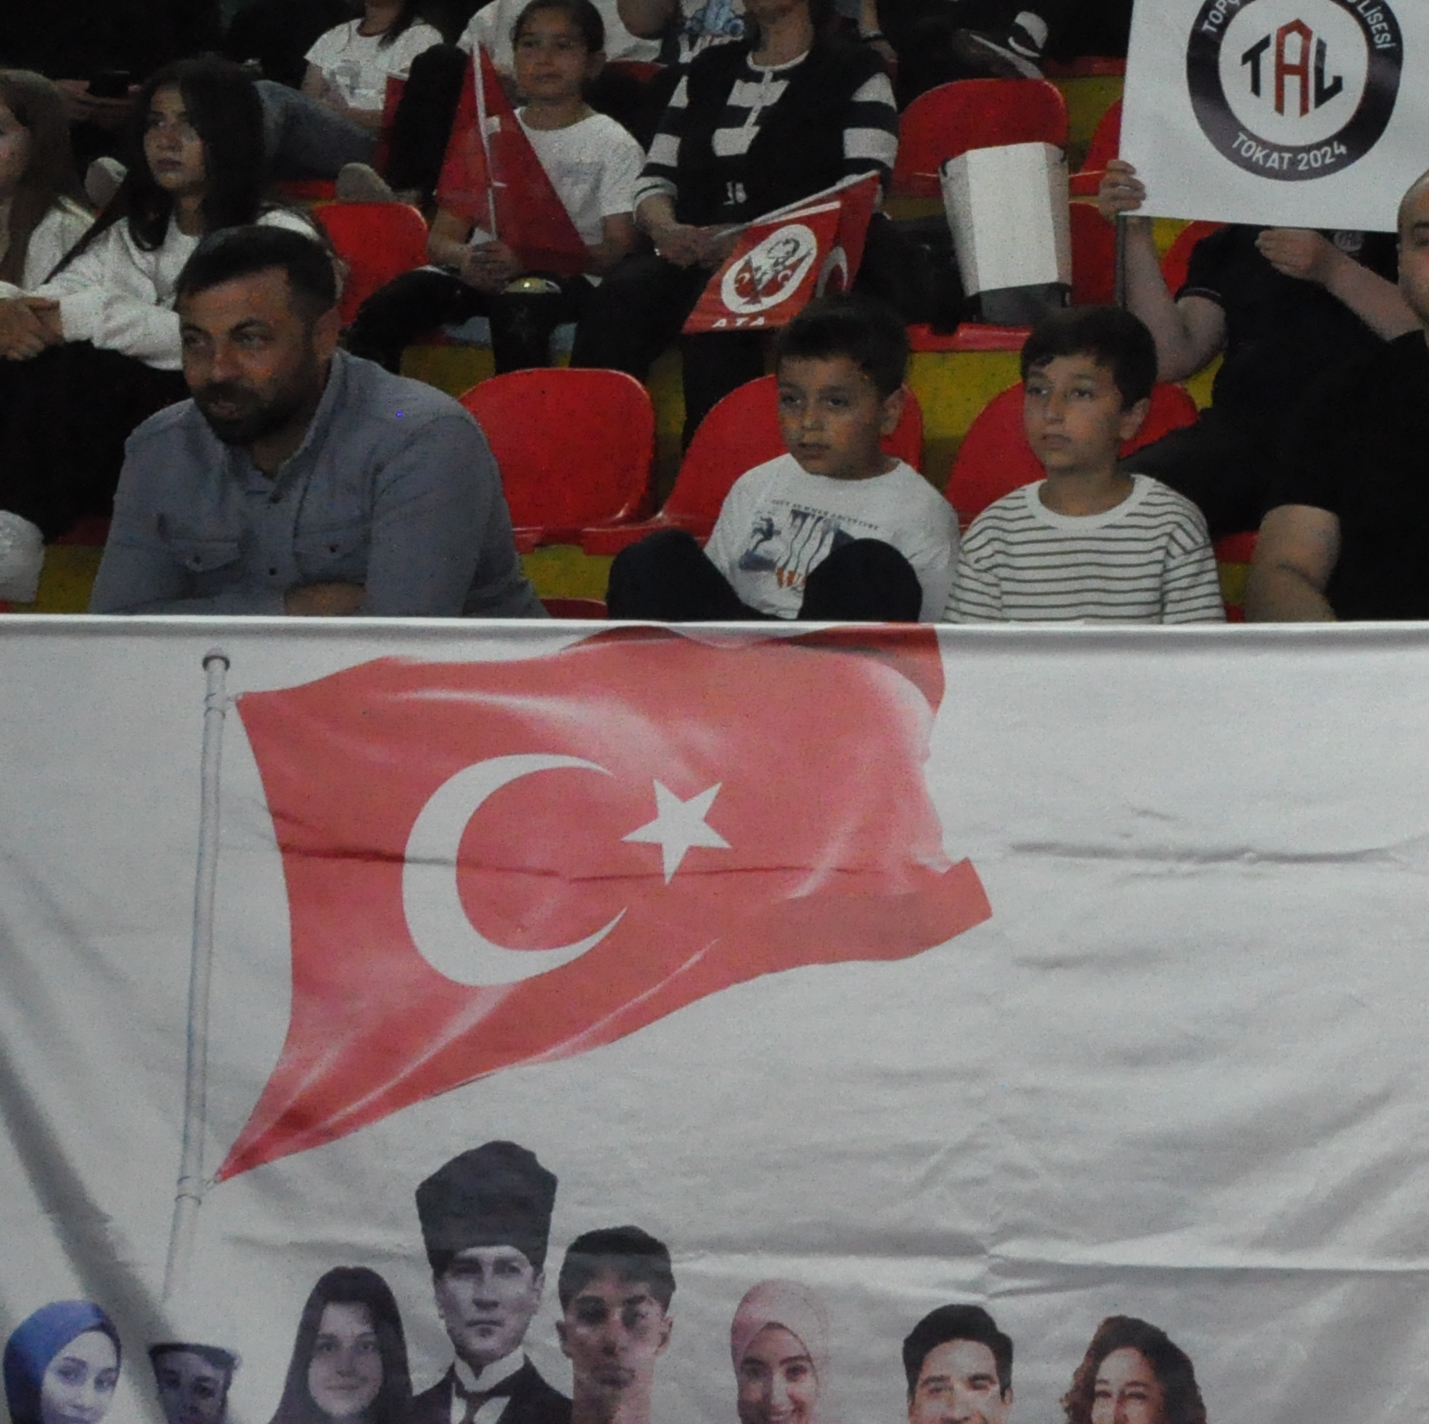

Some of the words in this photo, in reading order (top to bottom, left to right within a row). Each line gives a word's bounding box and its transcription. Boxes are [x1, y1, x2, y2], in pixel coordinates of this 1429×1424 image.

[1356, 0, 1396, 50] LİSESİ
[1241, 18, 1343, 119] TAL
[1231, 131, 1292, 171] TOKAT
[1297, 140, 1348, 171] 2024
